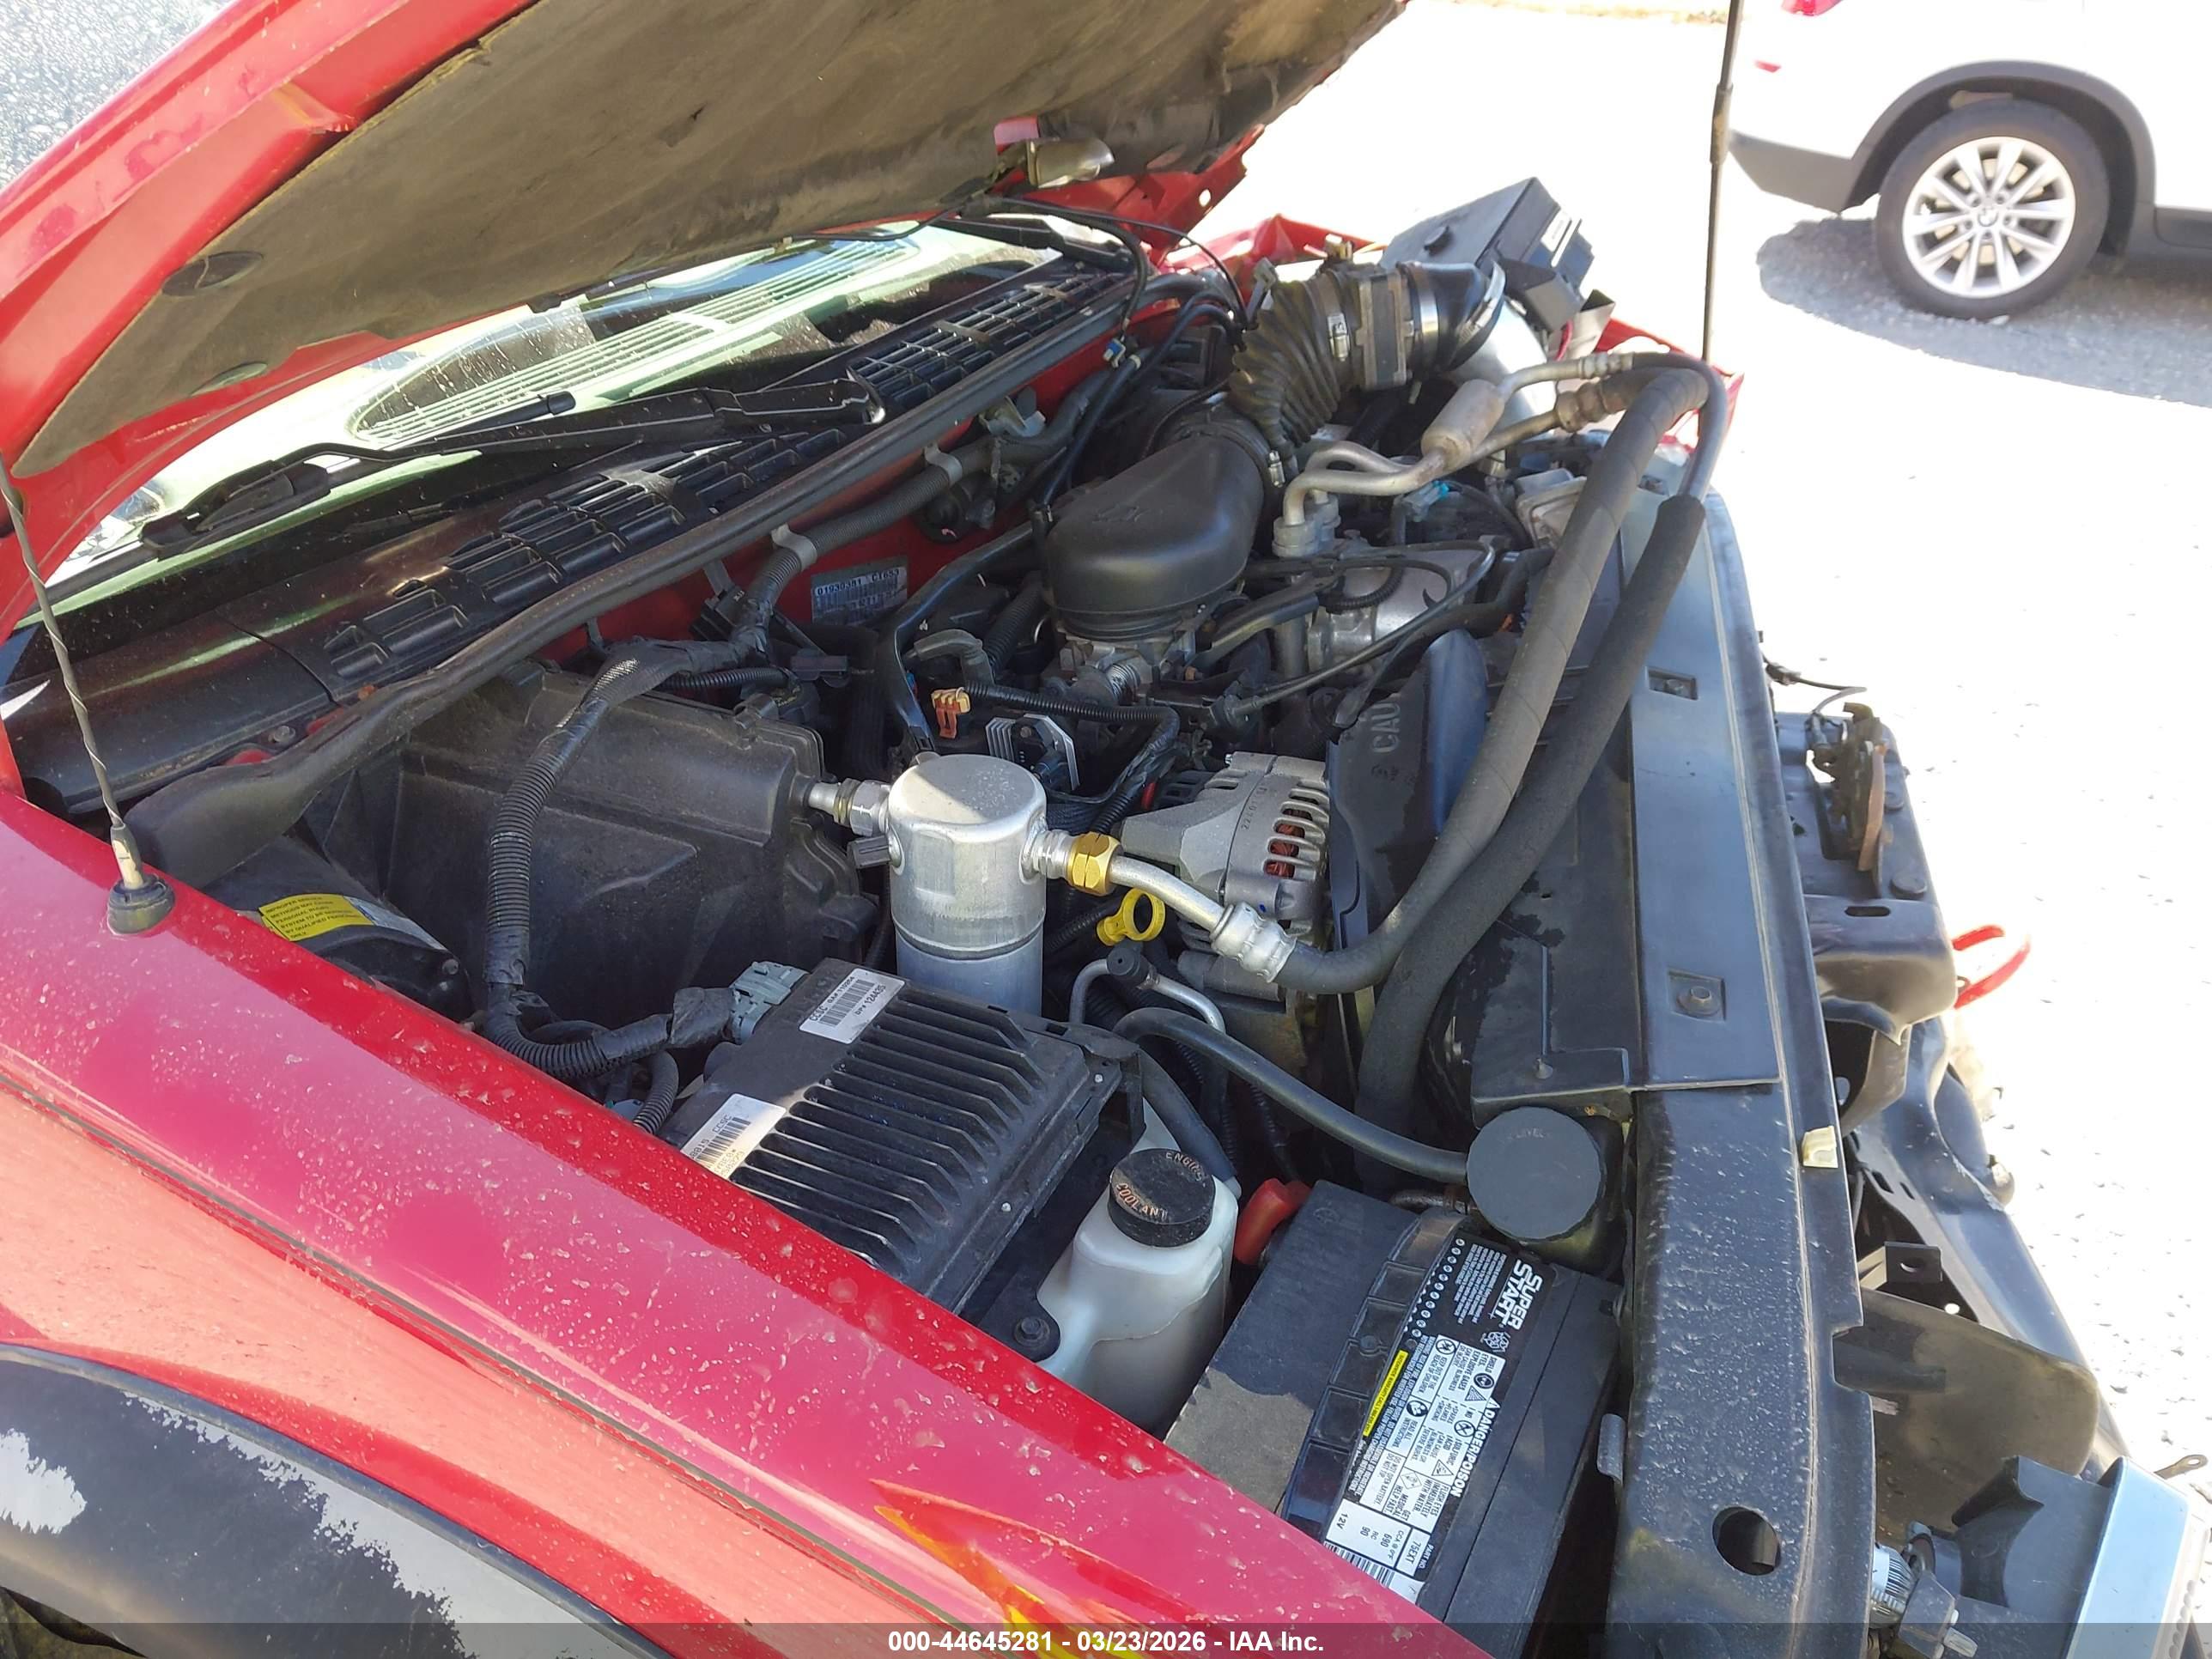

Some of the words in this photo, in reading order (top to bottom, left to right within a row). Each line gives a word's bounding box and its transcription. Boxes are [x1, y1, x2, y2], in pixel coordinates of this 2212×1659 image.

[1495, 1259, 1534, 1326] START
[1508, 1271, 1542, 1330] SUPER
[1449, 1408, 1496, 1498] DANGER/POISON
[1335, 1511, 1348, 1529] 12V
[1358, 1525, 1370, 1537] 90
[1370, 1530, 1378, 1540] RC
[1379, 1532, 1392, 1547] 690
[1404, 1540, 1421, 1564] 75EXT
[1422, 1543, 1434, 1559] PART
